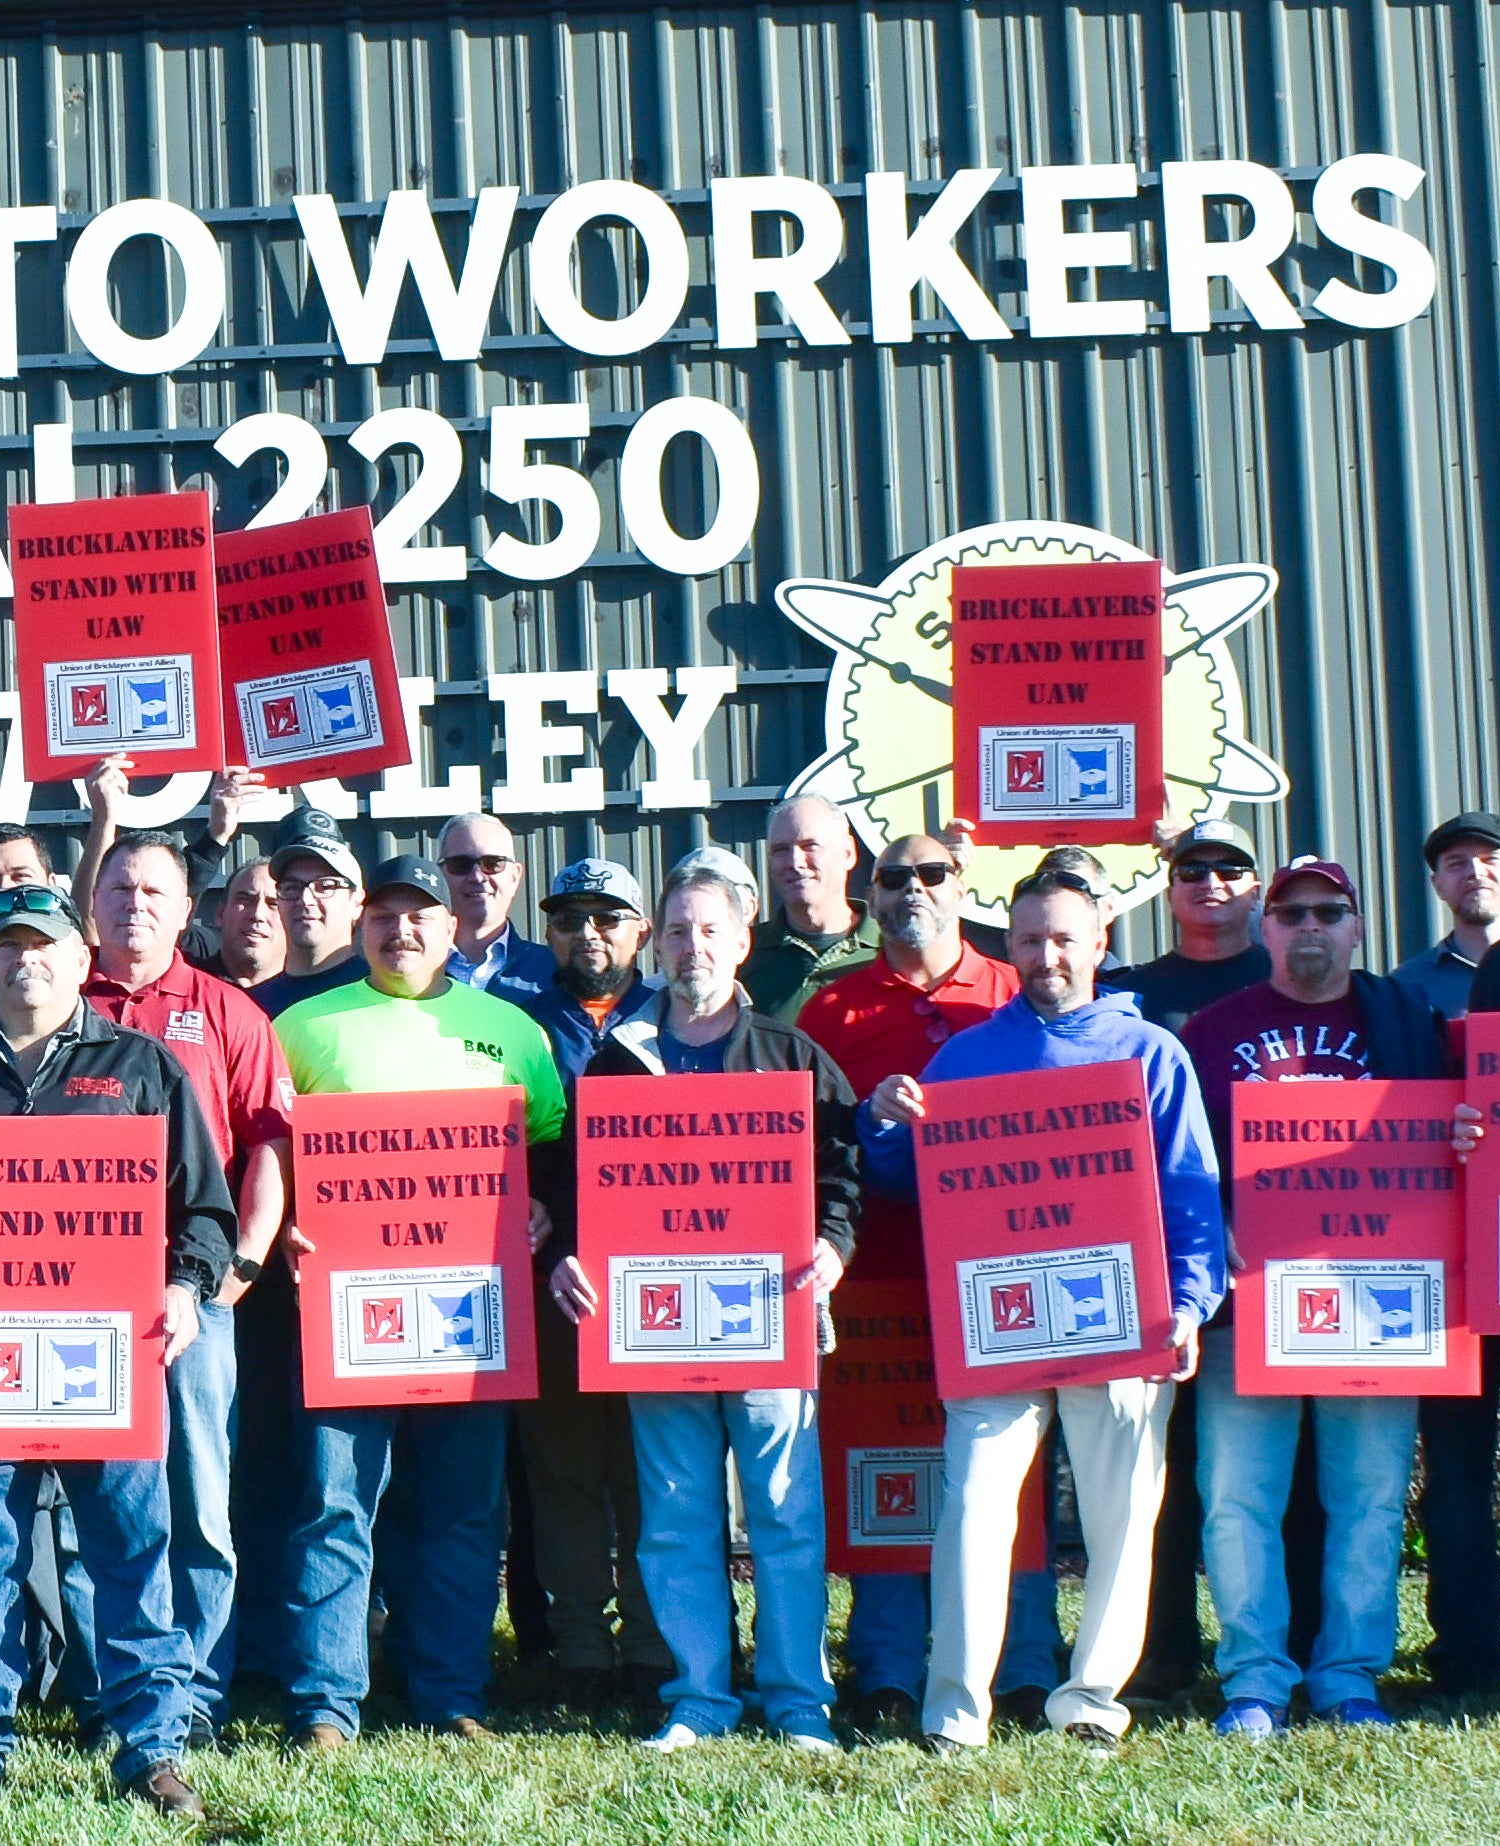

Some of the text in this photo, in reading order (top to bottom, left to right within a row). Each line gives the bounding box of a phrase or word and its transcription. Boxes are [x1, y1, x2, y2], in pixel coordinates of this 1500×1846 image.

[291, 151, 1437, 366] WORKERS
[214, 399, 760, 582] 2250
[18, 527, 206, 559] BRICKLAYERS
[216, 538, 370, 586] RICKLAYERS
[31, 571, 196, 602] STAND WITH
[218, 581, 367, 626] STAND WITH
[959, 594, 1156, 621] BRICKLAYERS
[86, 615, 145, 639] UAW
[268, 628, 324, 655] UAW
[970, 639, 1146, 665] STAND WITH
[60, 664, 83, 672] Union
[94, 662, 136, 670] Bricklayers
[183, 671, 192, 734] Craftworkers
[1027, 683, 1089, 705] UAW
[48, 680, 58, 740] International
[1124, 740, 1133, 804] Craftworkers
[585, 1110, 806, 1139] BRICKLAYERS
[921, 1098, 1142, 1147] BRICKLAYERS
[1242, 1119, 1455, 1144] BRICKLAYER
[301, 1123, 519, 1156] BRICKLAYERS
[598, 1160, 793, 1188] STAND WITH
[938, 1148, 1135, 1194] STAND WITH
[1255, 1166, 1455, 1192] STAND WITH
[316, 1172, 509, 1205] STAND WITH
[54, 1210, 144, 1236] WITH
[661, 1208, 731, 1233] UAW
[1005, 1202, 1075, 1233] UAW
[1320, 1213, 1392, 1237] UAW
[380, 1221, 449, 1247] UAW
[2, 1261, 76, 1287] UAW
[0, 1315, 7, 1324] of
[9, 1316, 61, 1326] Bricklayers
[64, 1316, 82, 1324] and
[85, 1316, 112, 1324] Allied
[119, 1332, 128, 1410] Craftworkers
